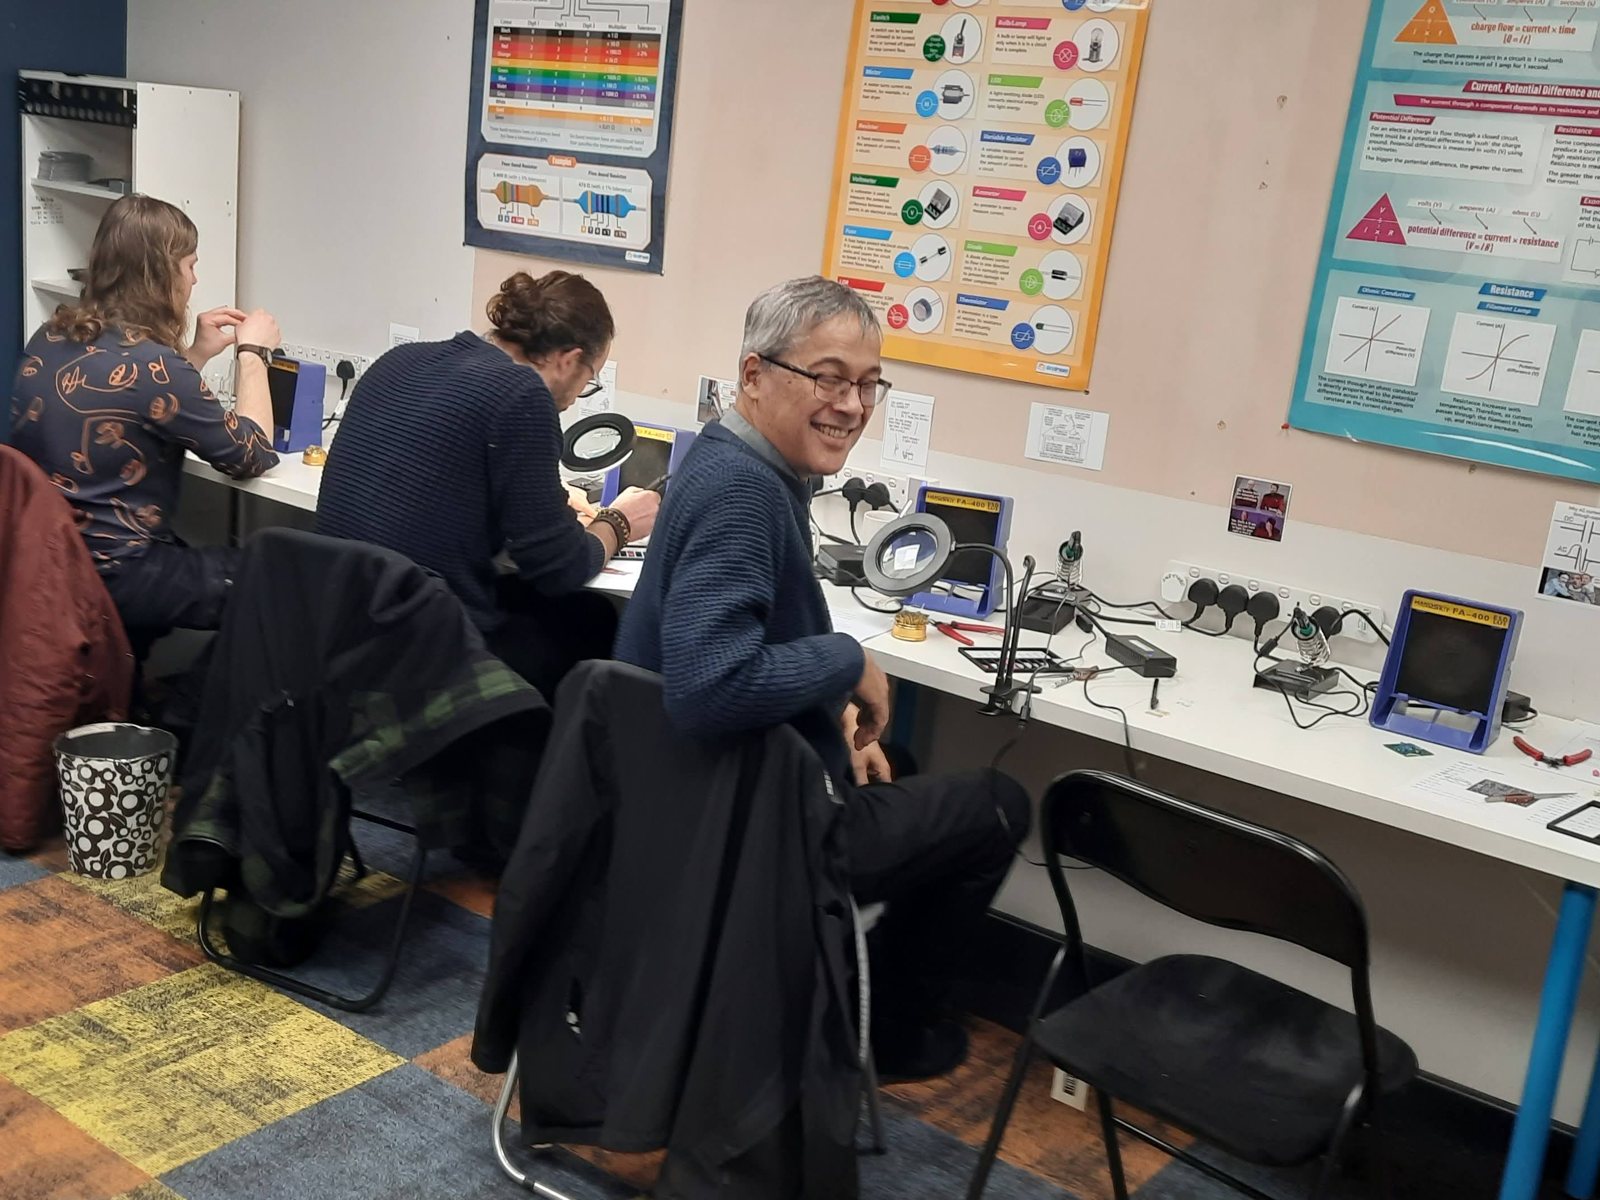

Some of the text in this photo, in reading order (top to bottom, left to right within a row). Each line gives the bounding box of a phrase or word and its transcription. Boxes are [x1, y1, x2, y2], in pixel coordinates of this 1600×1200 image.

[1471, 22, 1495, 33] charge
[1497, 23, 1513, 31] flow
[1521, 25, 1550, 33] current
[1558, 26, 1576, 34] time
[1471, 82, 1503, 93] Current,
[1504, 84, 1541, 94] Potential
[1542, 86, 1584, 96] Difference
[1513, 104, 1537, 112] depends
[1453, 131, 1476, 139] through
[1408, 226, 1438, 237] potential
[1439, 229, 1475, 239] difference
[1483, 235, 1511, 243] current
[1518, 238, 1558, 248] resistance
[1491, 285, 1534, 298] Resistance
[1487, 304, 1530, 315] Filament Lamp
[956, 499, 985, 508] FA-400
[1453, 608, 1490, 621] FA-400
